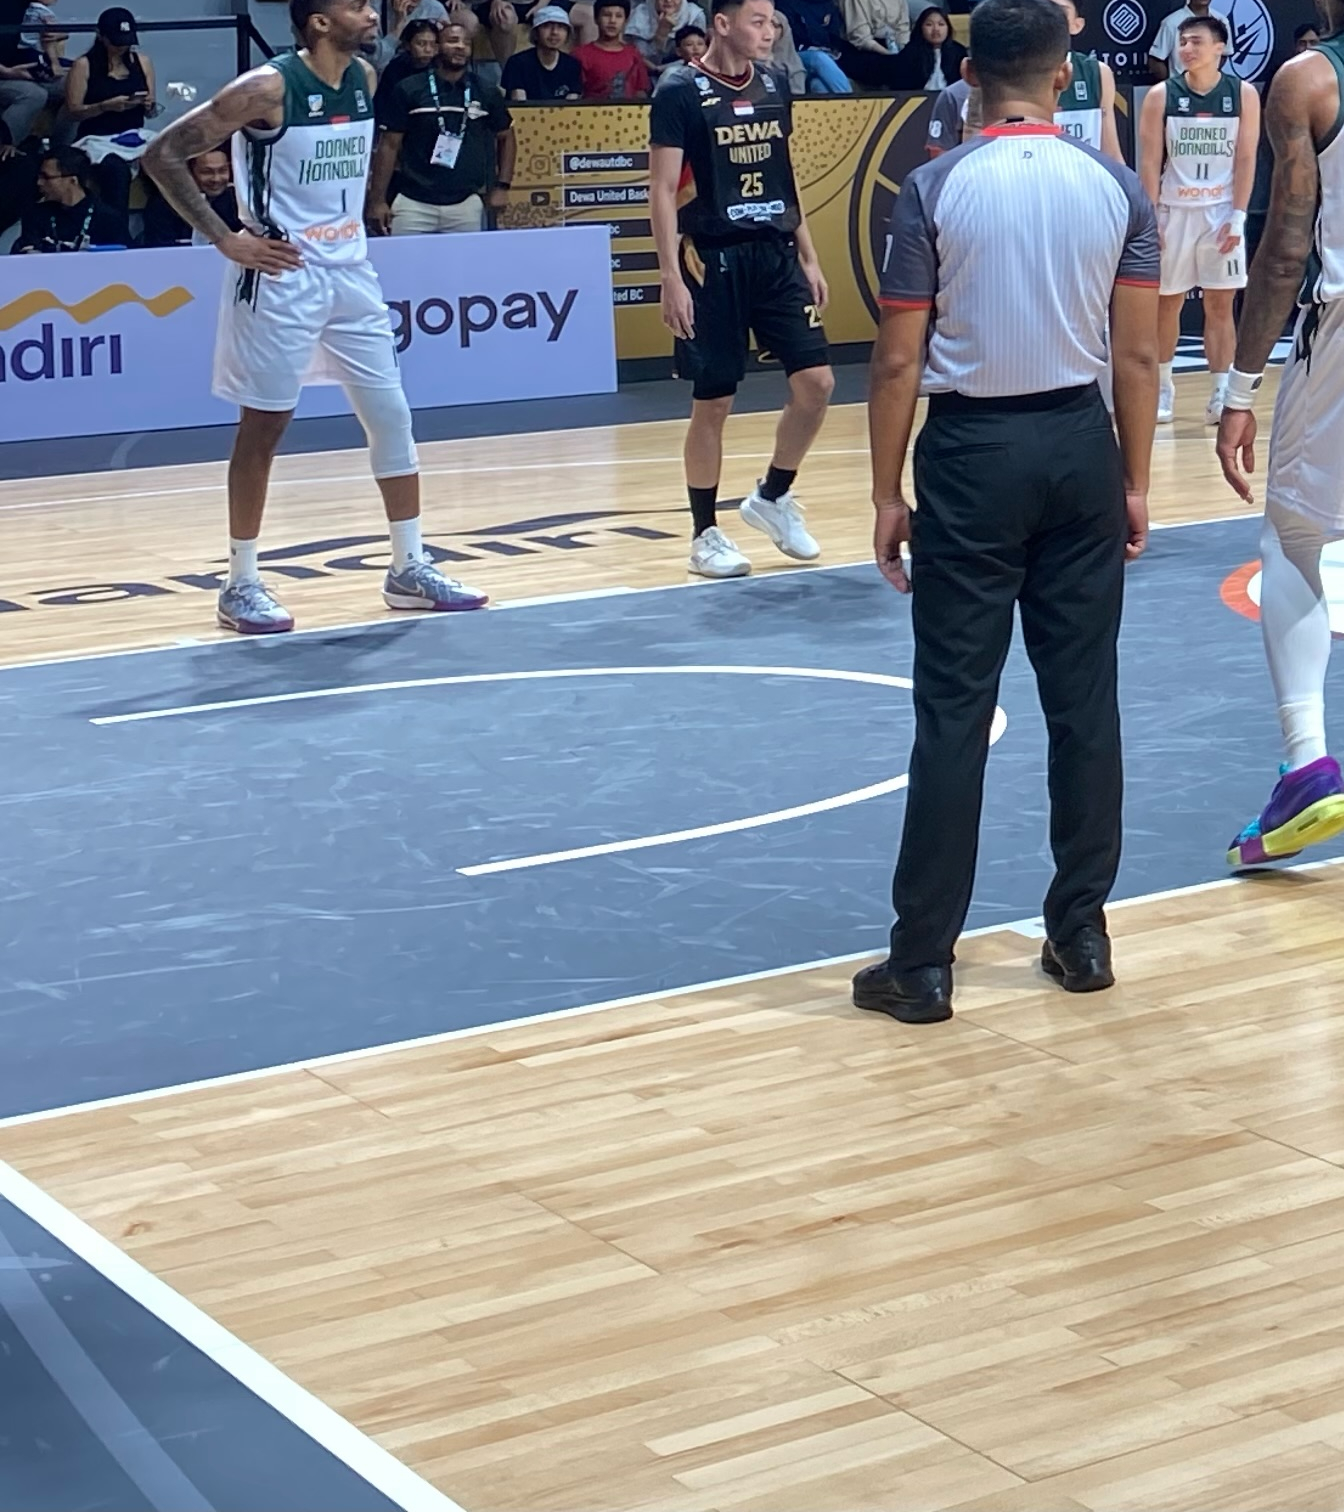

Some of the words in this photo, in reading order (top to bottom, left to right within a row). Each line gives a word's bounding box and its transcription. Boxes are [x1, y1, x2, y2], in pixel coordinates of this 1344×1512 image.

[714, 120, 783, 146] DEWA
[1180, 128, 1227, 142] BORNEO
[315, 136, 366, 160] BORNEO
[729, 143, 771, 164] UNITED
[1170, 141, 1234, 158] HORNBILLS
[1196, 163, 1209, 180] 11
[740, 172, 764, 198] 25
[569, 190, 595, 204] Dewa
[596, 188, 623, 202] United
[1227, 258, 1240, 277] 11
[384, 289, 579, 355] gopay
